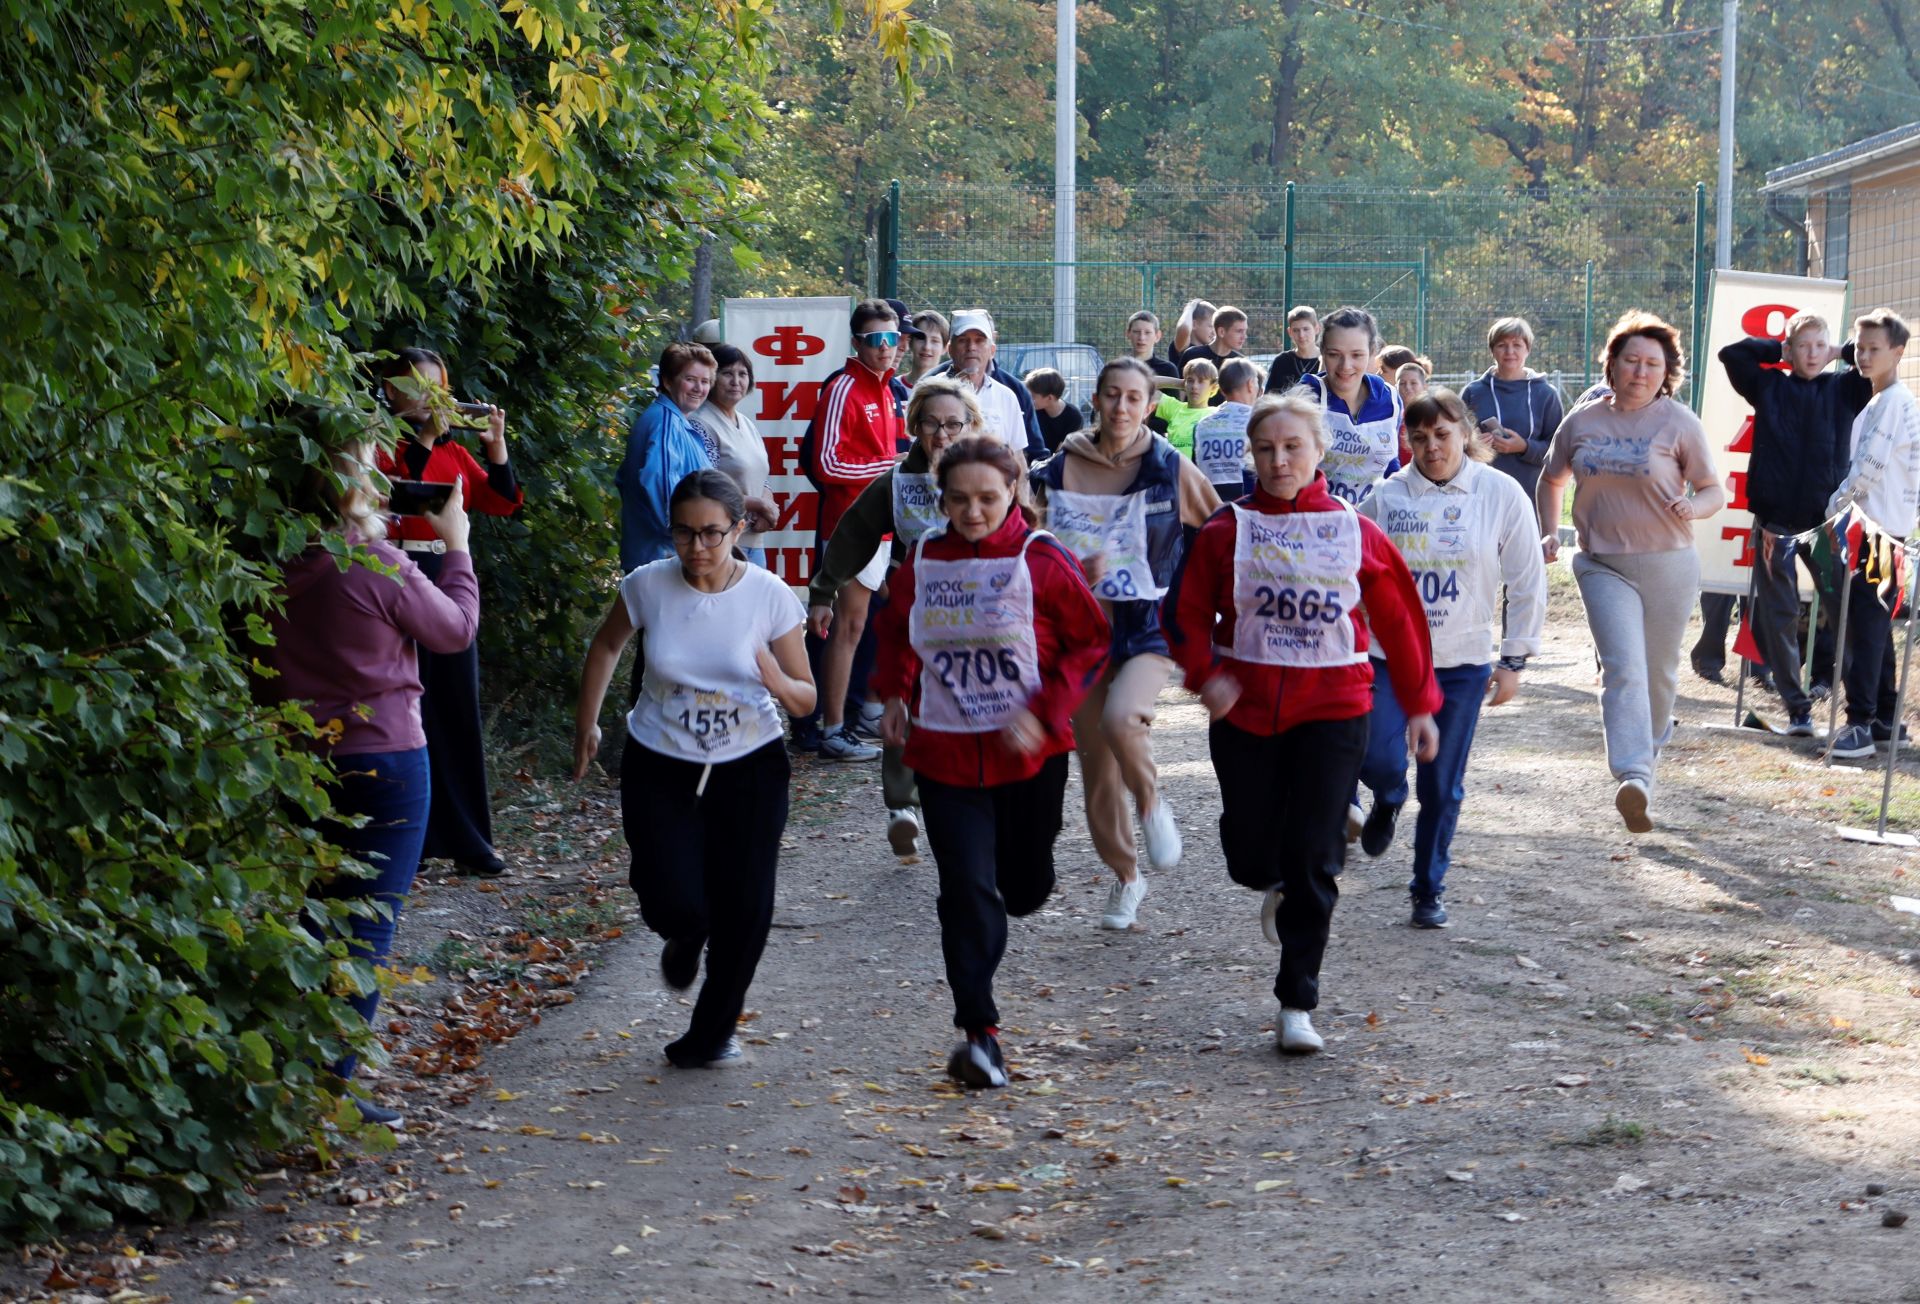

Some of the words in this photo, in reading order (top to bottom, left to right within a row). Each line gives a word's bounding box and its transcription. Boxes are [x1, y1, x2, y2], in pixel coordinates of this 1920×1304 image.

[1333, 429, 1362, 443] РОСС
[1201, 439, 1245, 461] 2908
[1331, 441, 1371, 455] АЦИИ
[752, 326, 826, 586] ФИНИШ
[1387, 509, 1420, 522] КРОСС
[1387, 521, 1429, 534] НАЦИИ
[925, 580, 964, 594] КРОСС
[925, 592, 975, 608] НАЦИИ
[1254, 586, 1343, 623] 2665
[1267, 636, 1320, 649] ТАТАРСТАН
[933, 649, 1020, 689] 2706
[678, 707, 741, 736] 1551
